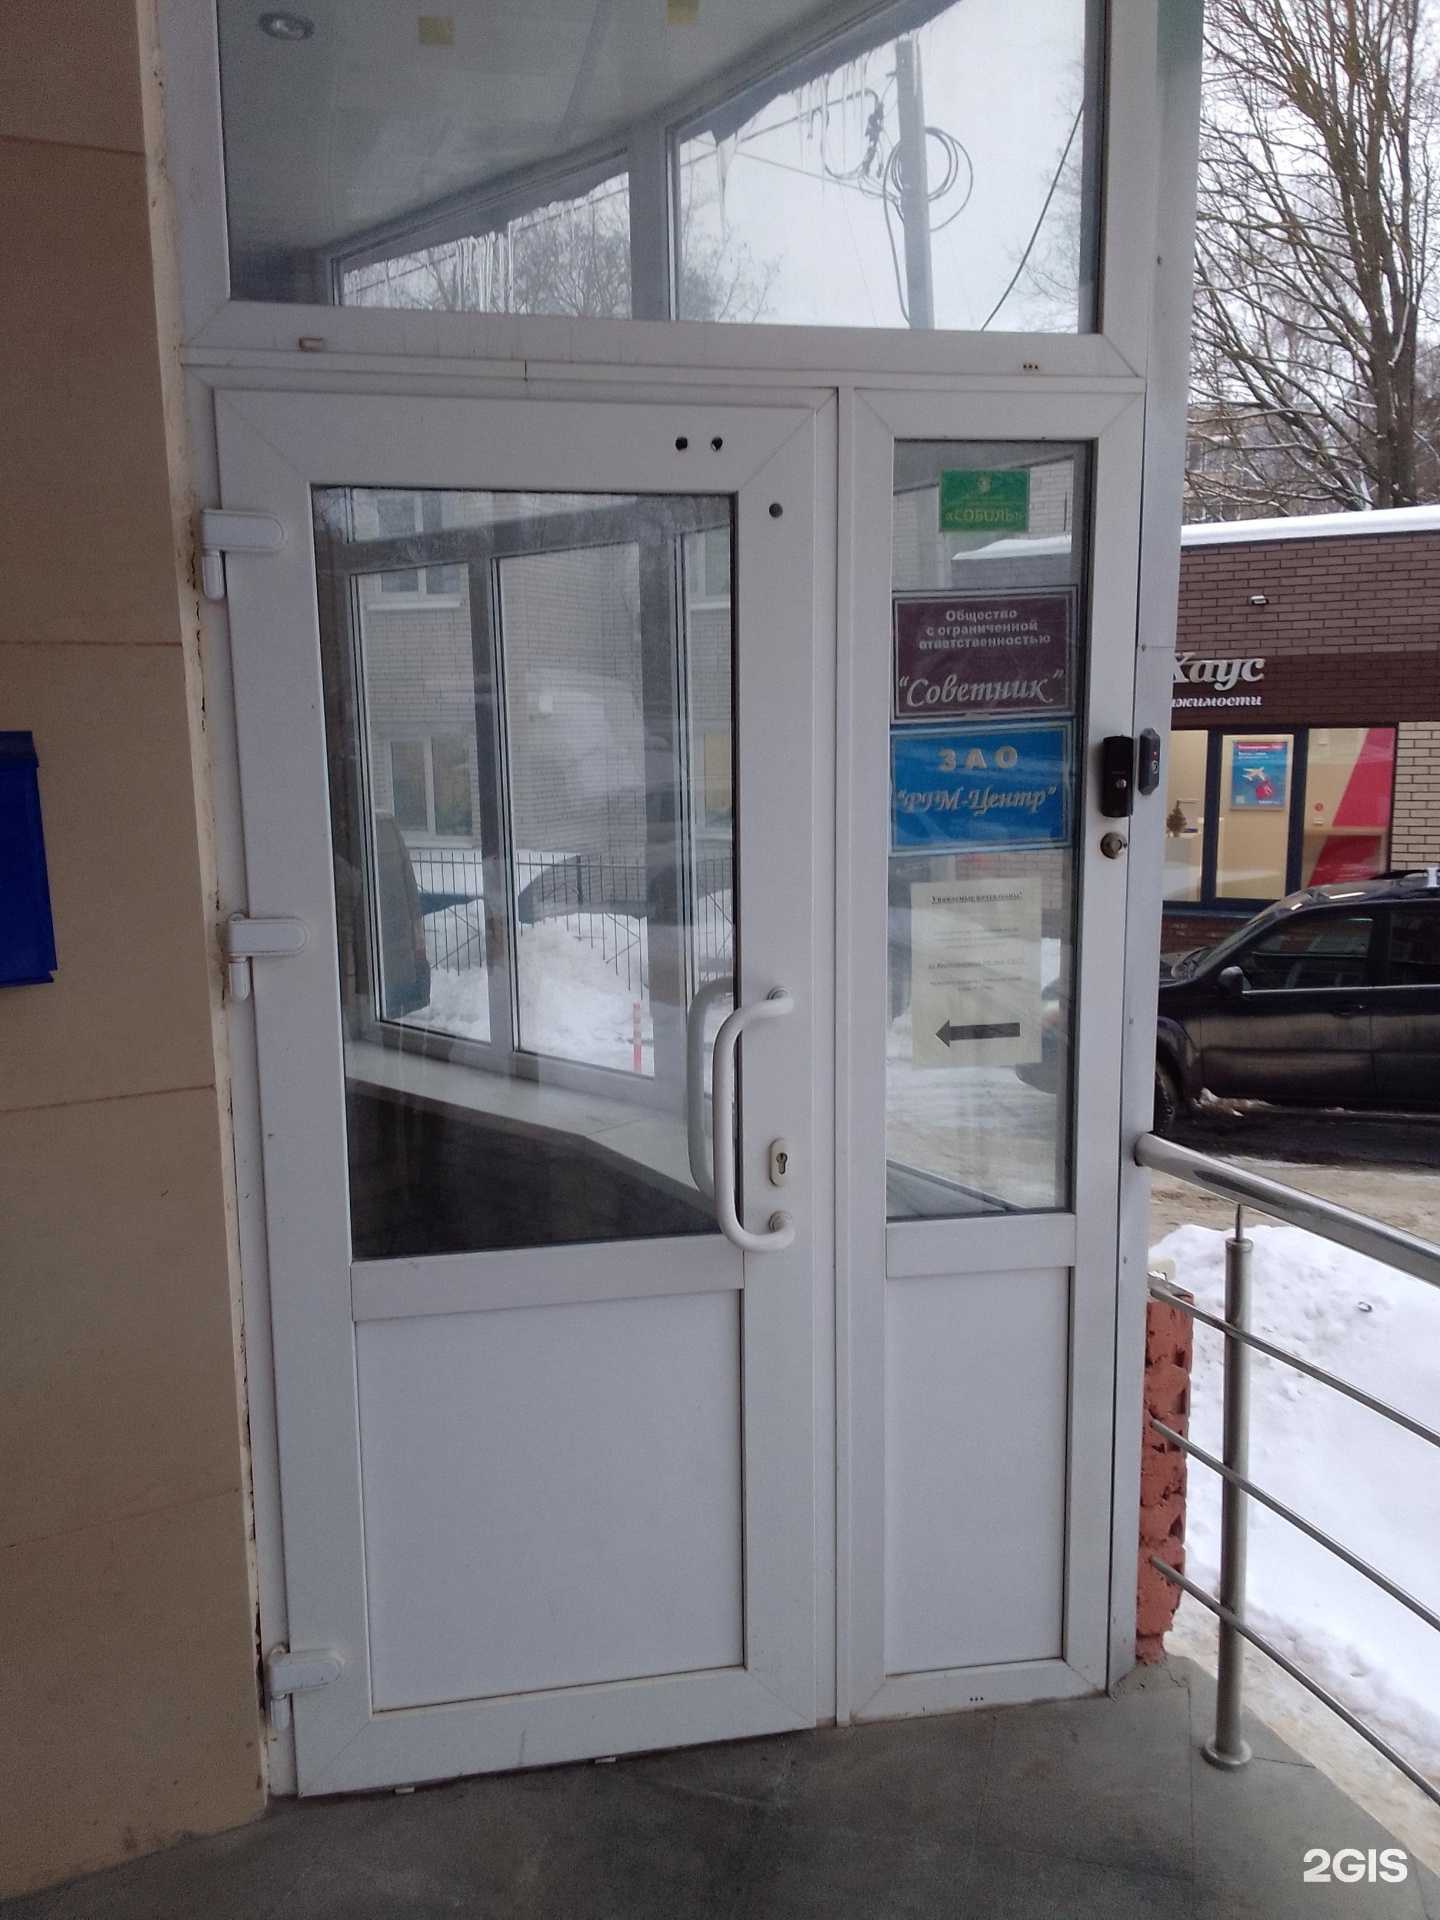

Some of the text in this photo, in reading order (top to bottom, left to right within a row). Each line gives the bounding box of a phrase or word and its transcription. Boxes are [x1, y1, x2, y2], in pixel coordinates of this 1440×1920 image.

[946, 609, 1018, 622] Общество
[926, 620, 1038, 637] с ограниченной
[919, 635, 1051, 650] ответственностью
